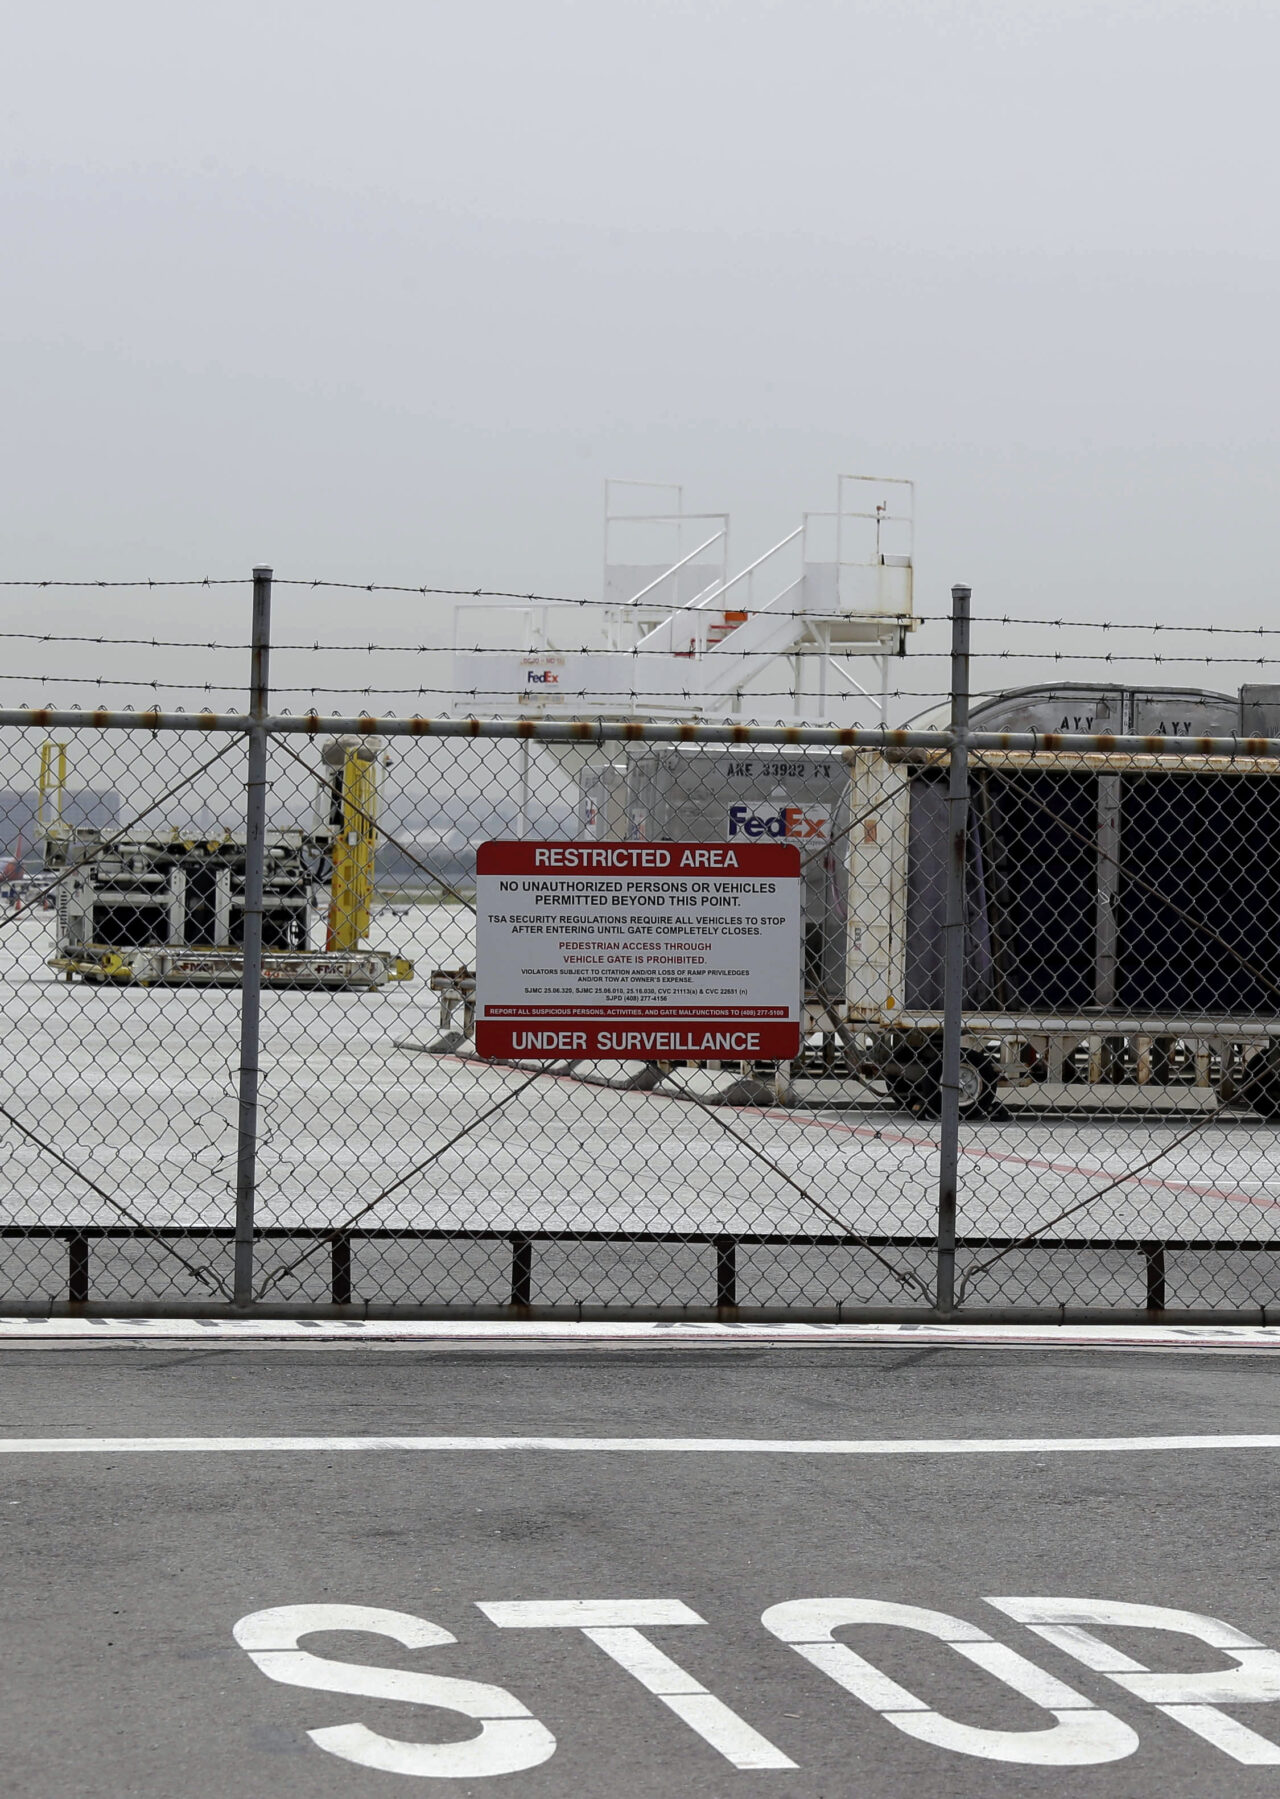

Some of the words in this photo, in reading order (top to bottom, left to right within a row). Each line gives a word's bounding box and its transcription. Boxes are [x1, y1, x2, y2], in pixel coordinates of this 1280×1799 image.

[528, 670, 558, 683] FedEx
[1060, 717, 1094, 730] AYY
[1159, 722, 1192, 734] AYY
[729, 806, 826, 839] FedEx
[535, 848, 671, 867] RESTRICTED
[679, 850, 739, 868] AREA
[500, 881, 519, 892] NO
[522, 881, 623, 892] UNAUTHORIZED
[626, 882, 688, 893] PERSONS
[691, 882, 710, 893] OR
[713, 883, 776, 893] VEHICLES
[535, 894, 608, 905] PERMITTED
[611, 895, 665, 906] BEYOND
[669, 896, 697, 906] THIS
[701, 896, 741, 907] POINT.
[488, 915, 507, 923] TSA
[509, 915, 557, 924] SECURITY
[560, 915, 627, 924] REGULATIONS
[630, 916, 673, 925] REQUIRE
[675, 917, 693, 925] ALL
[696, 917, 743, 925] VEHICLES
[745, 917, 758, 925] TO
[761, 917, 786, 926] STOP
[512, 925, 543, 934] AFTER
[546, 926, 595, 934] ENTERING
[597, 926, 625, 934] UNTIL
[627, 926, 653, 935] GATE
[656, 926, 719, 935] COMPLETELY
[721, 927, 762, 936] CLOSES.
[559, 942, 620, 950] PEDESTRIAN
[622, 942, 662, 951] ACCESS
[664, 942, 712, 951] THROUGH
[563, 955, 604, 964] VEHICLE
[607, 956, 632, 964] GATE
[635, 956, 644, 964] IS
[646, 956, 707, 964] PROHIBITED.
[315, 964, 344, 974] FMC
[512, 1031, 587, 1050] UNDER
[597, 1031, 761, 1050] SURVEILLANCE
